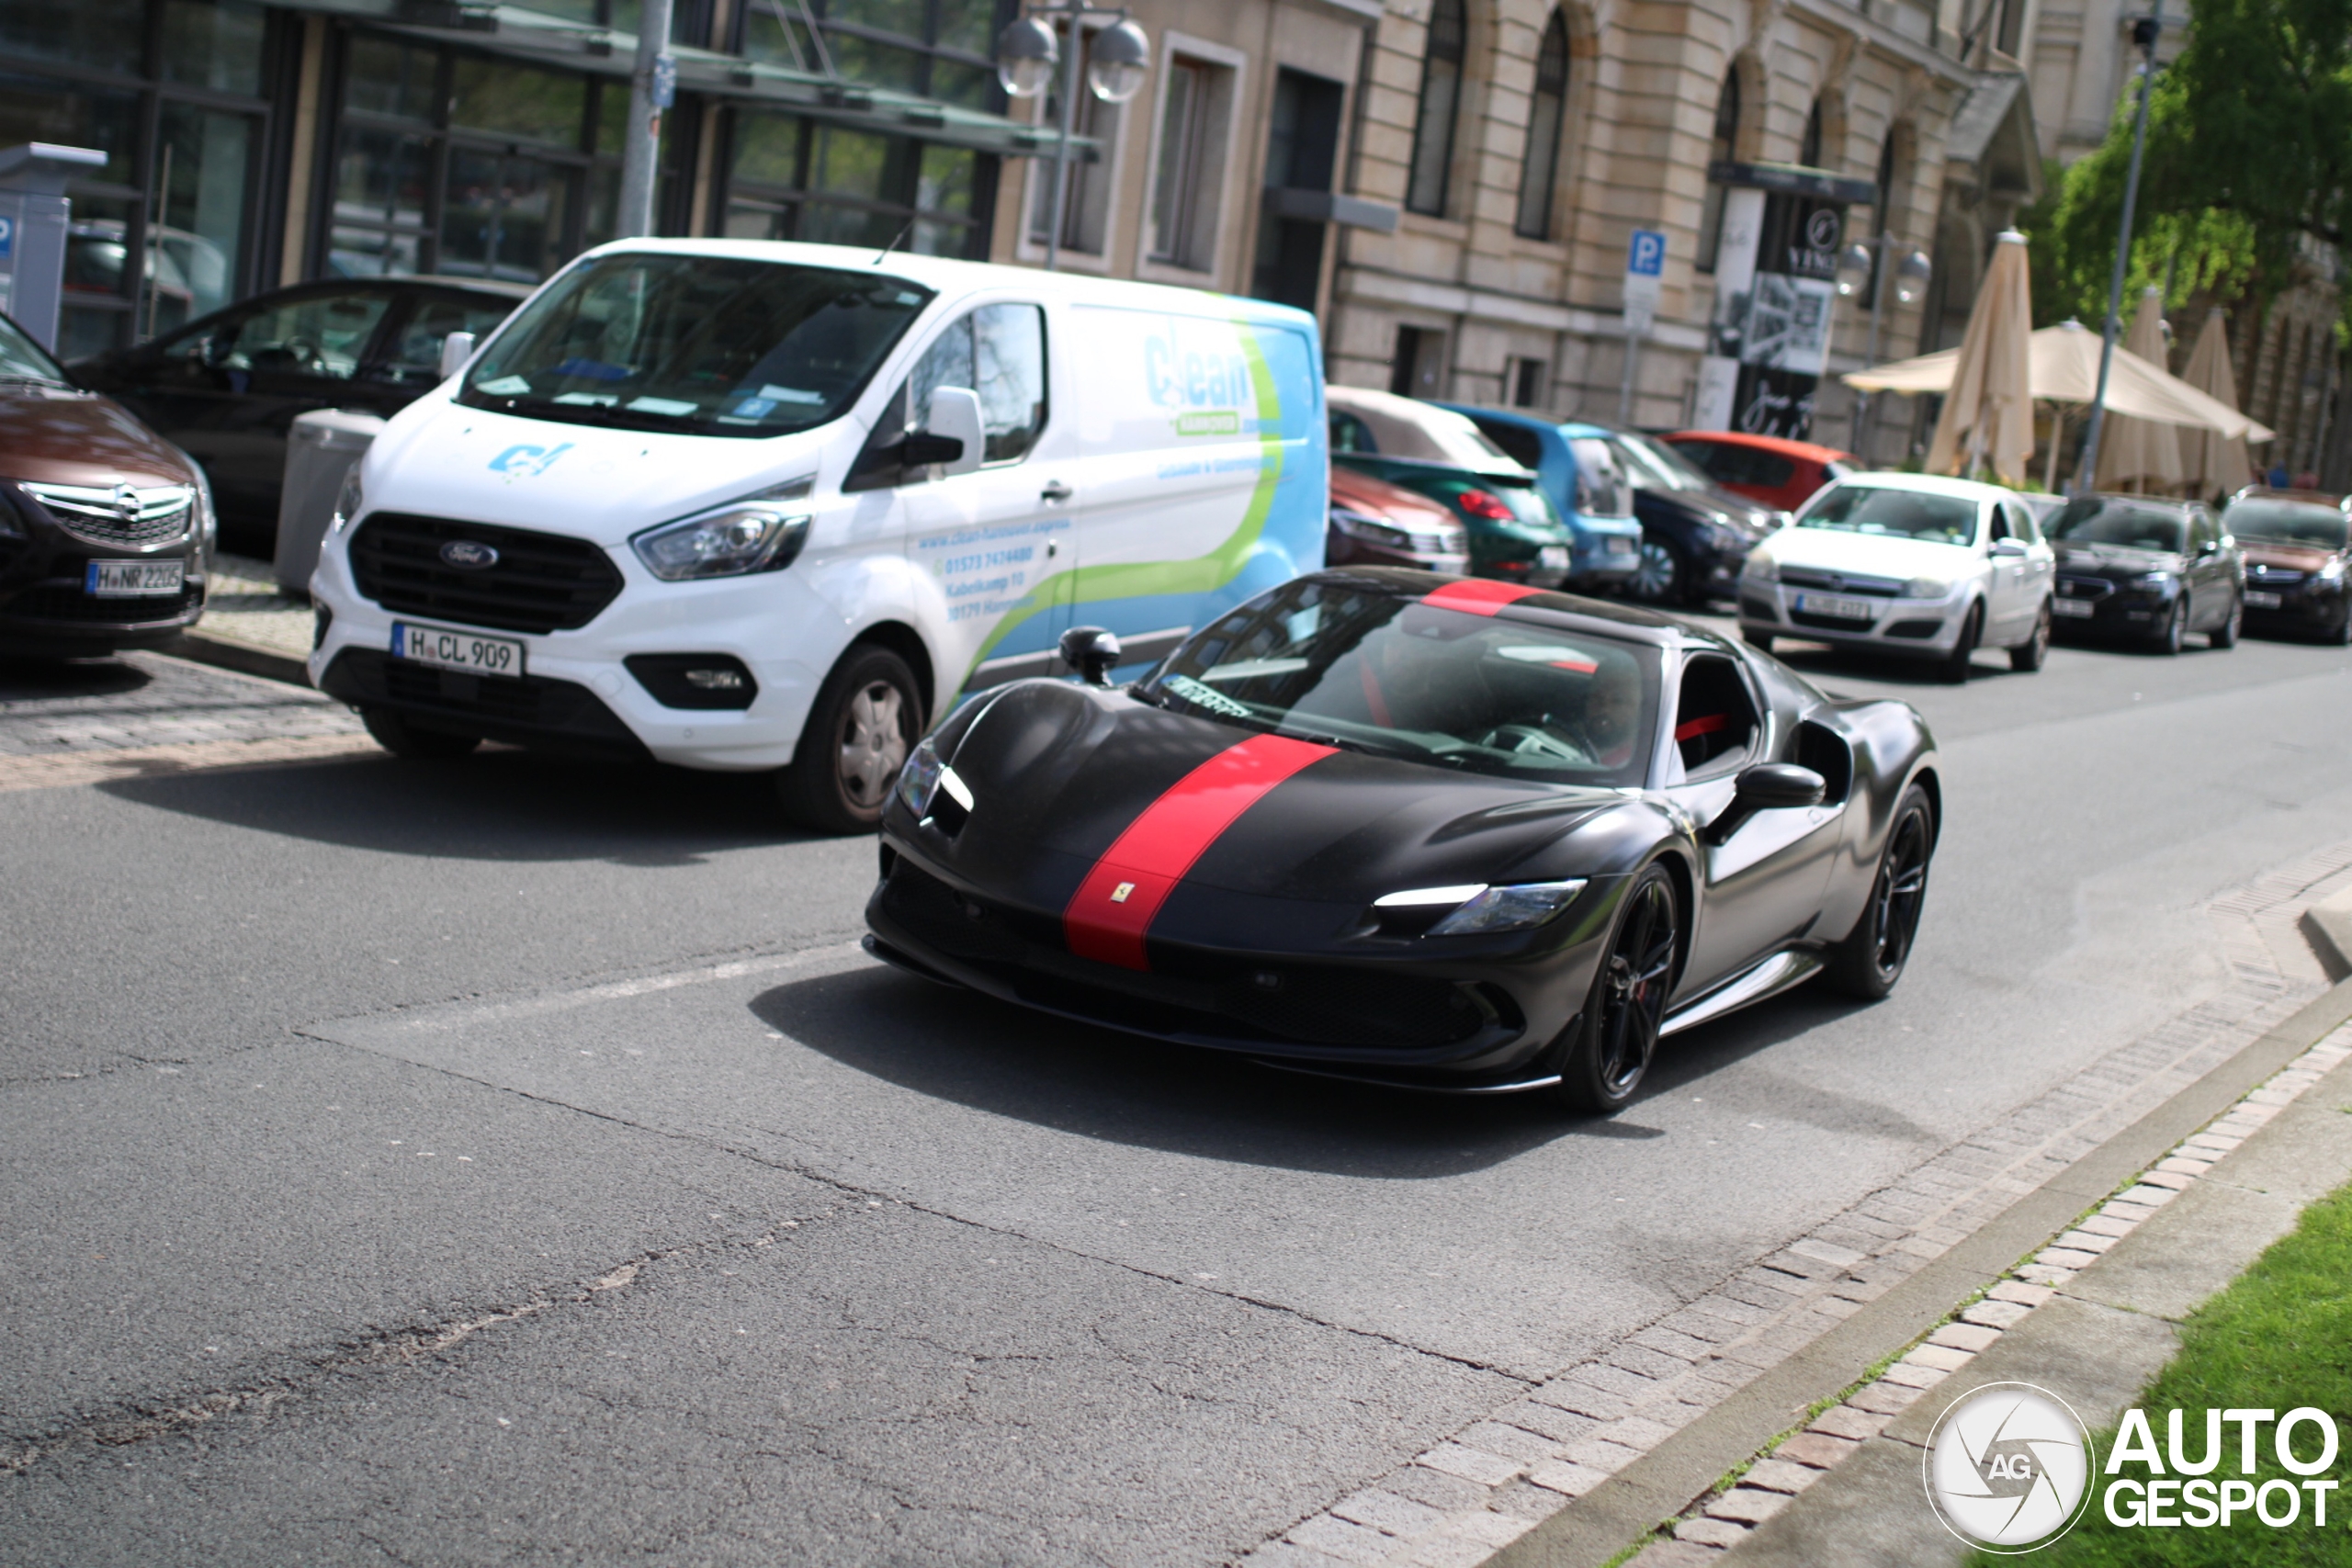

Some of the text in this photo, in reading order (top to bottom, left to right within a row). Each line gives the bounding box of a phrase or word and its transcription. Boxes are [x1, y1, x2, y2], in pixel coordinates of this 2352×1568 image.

[1635, 236, 1659, 268] P
[448, 542, 482, 563] Ford
[97, 568, 109, 588] H
[120, 568, 141, 588] NR
[411, 630, 511, 670] H CL 909
